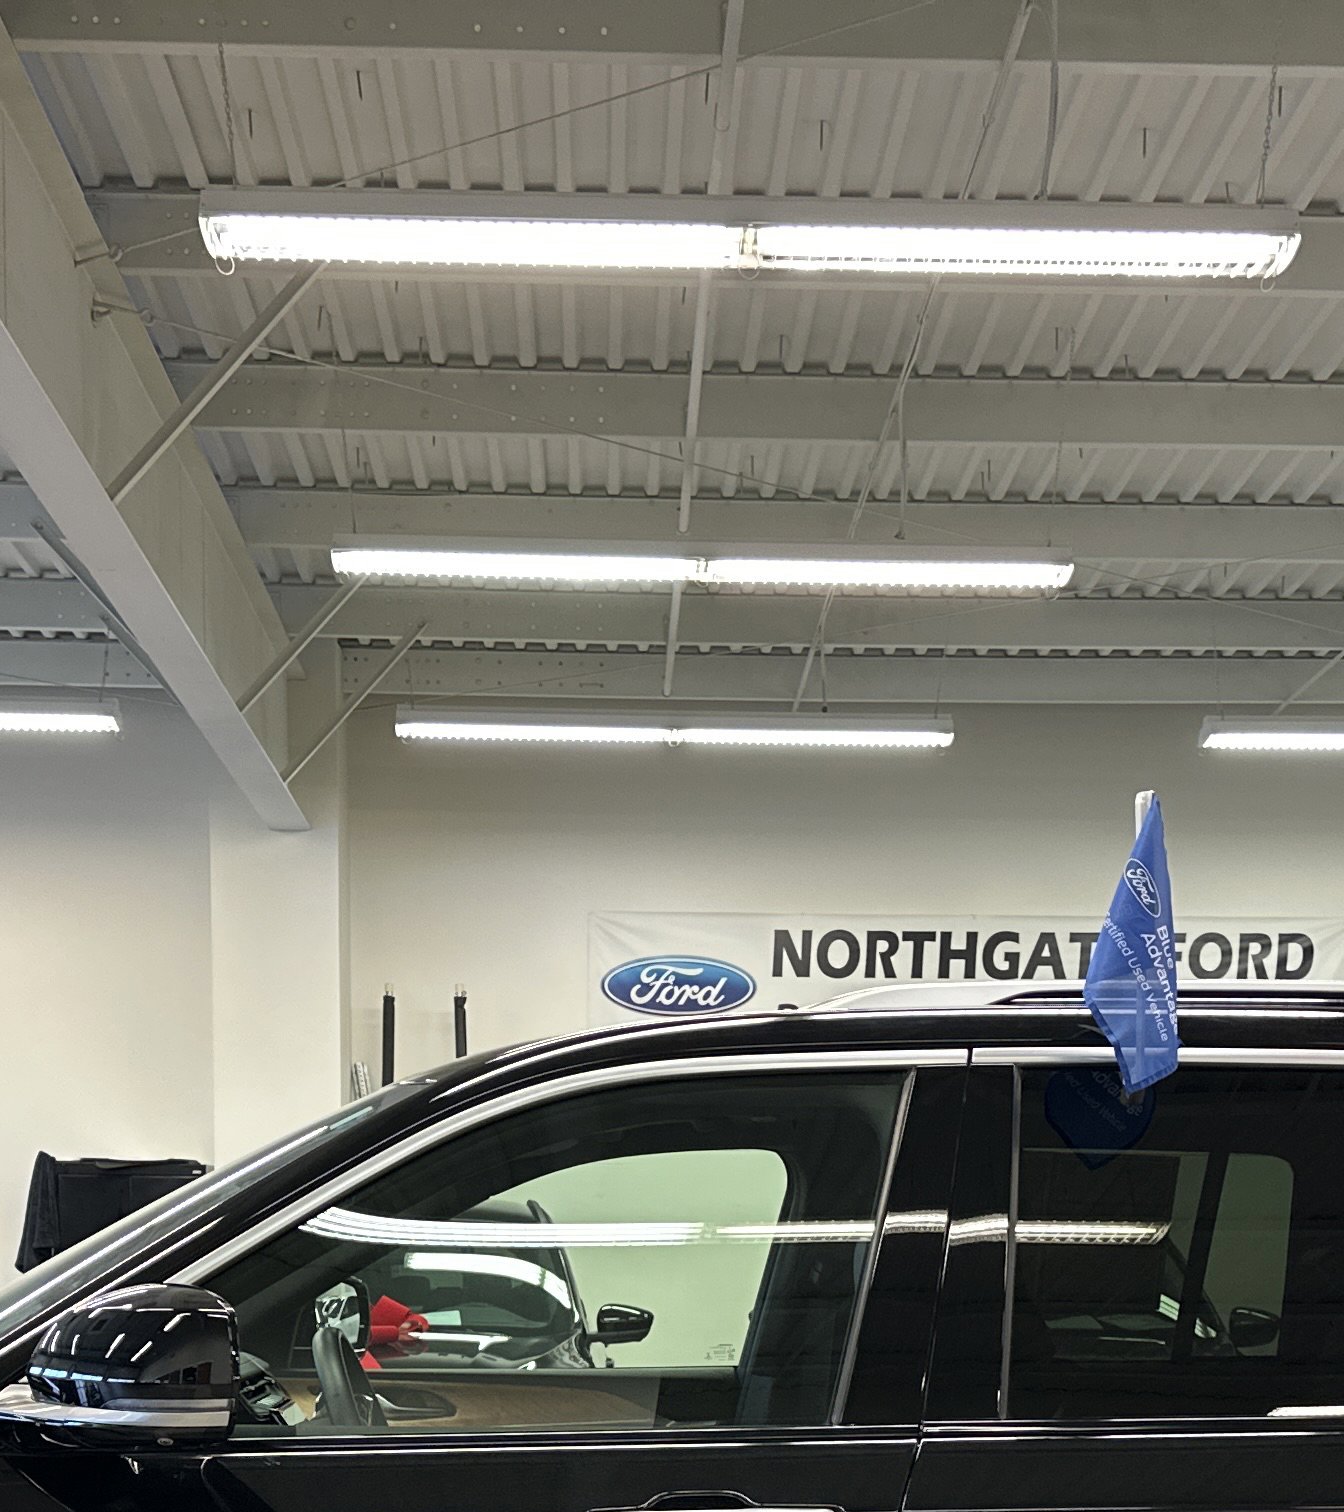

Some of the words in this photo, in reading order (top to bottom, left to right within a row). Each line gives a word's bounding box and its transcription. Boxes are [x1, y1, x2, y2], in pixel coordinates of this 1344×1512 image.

[772, 929, 1097, 980] NORTHGAT
[1157, 925, 1175, 969] Blue
[1104, 911, 1135, 957] ertified
[1128, 957, 1152, 991] Used
[1146, 992, 1169, 1042] Vehicle
